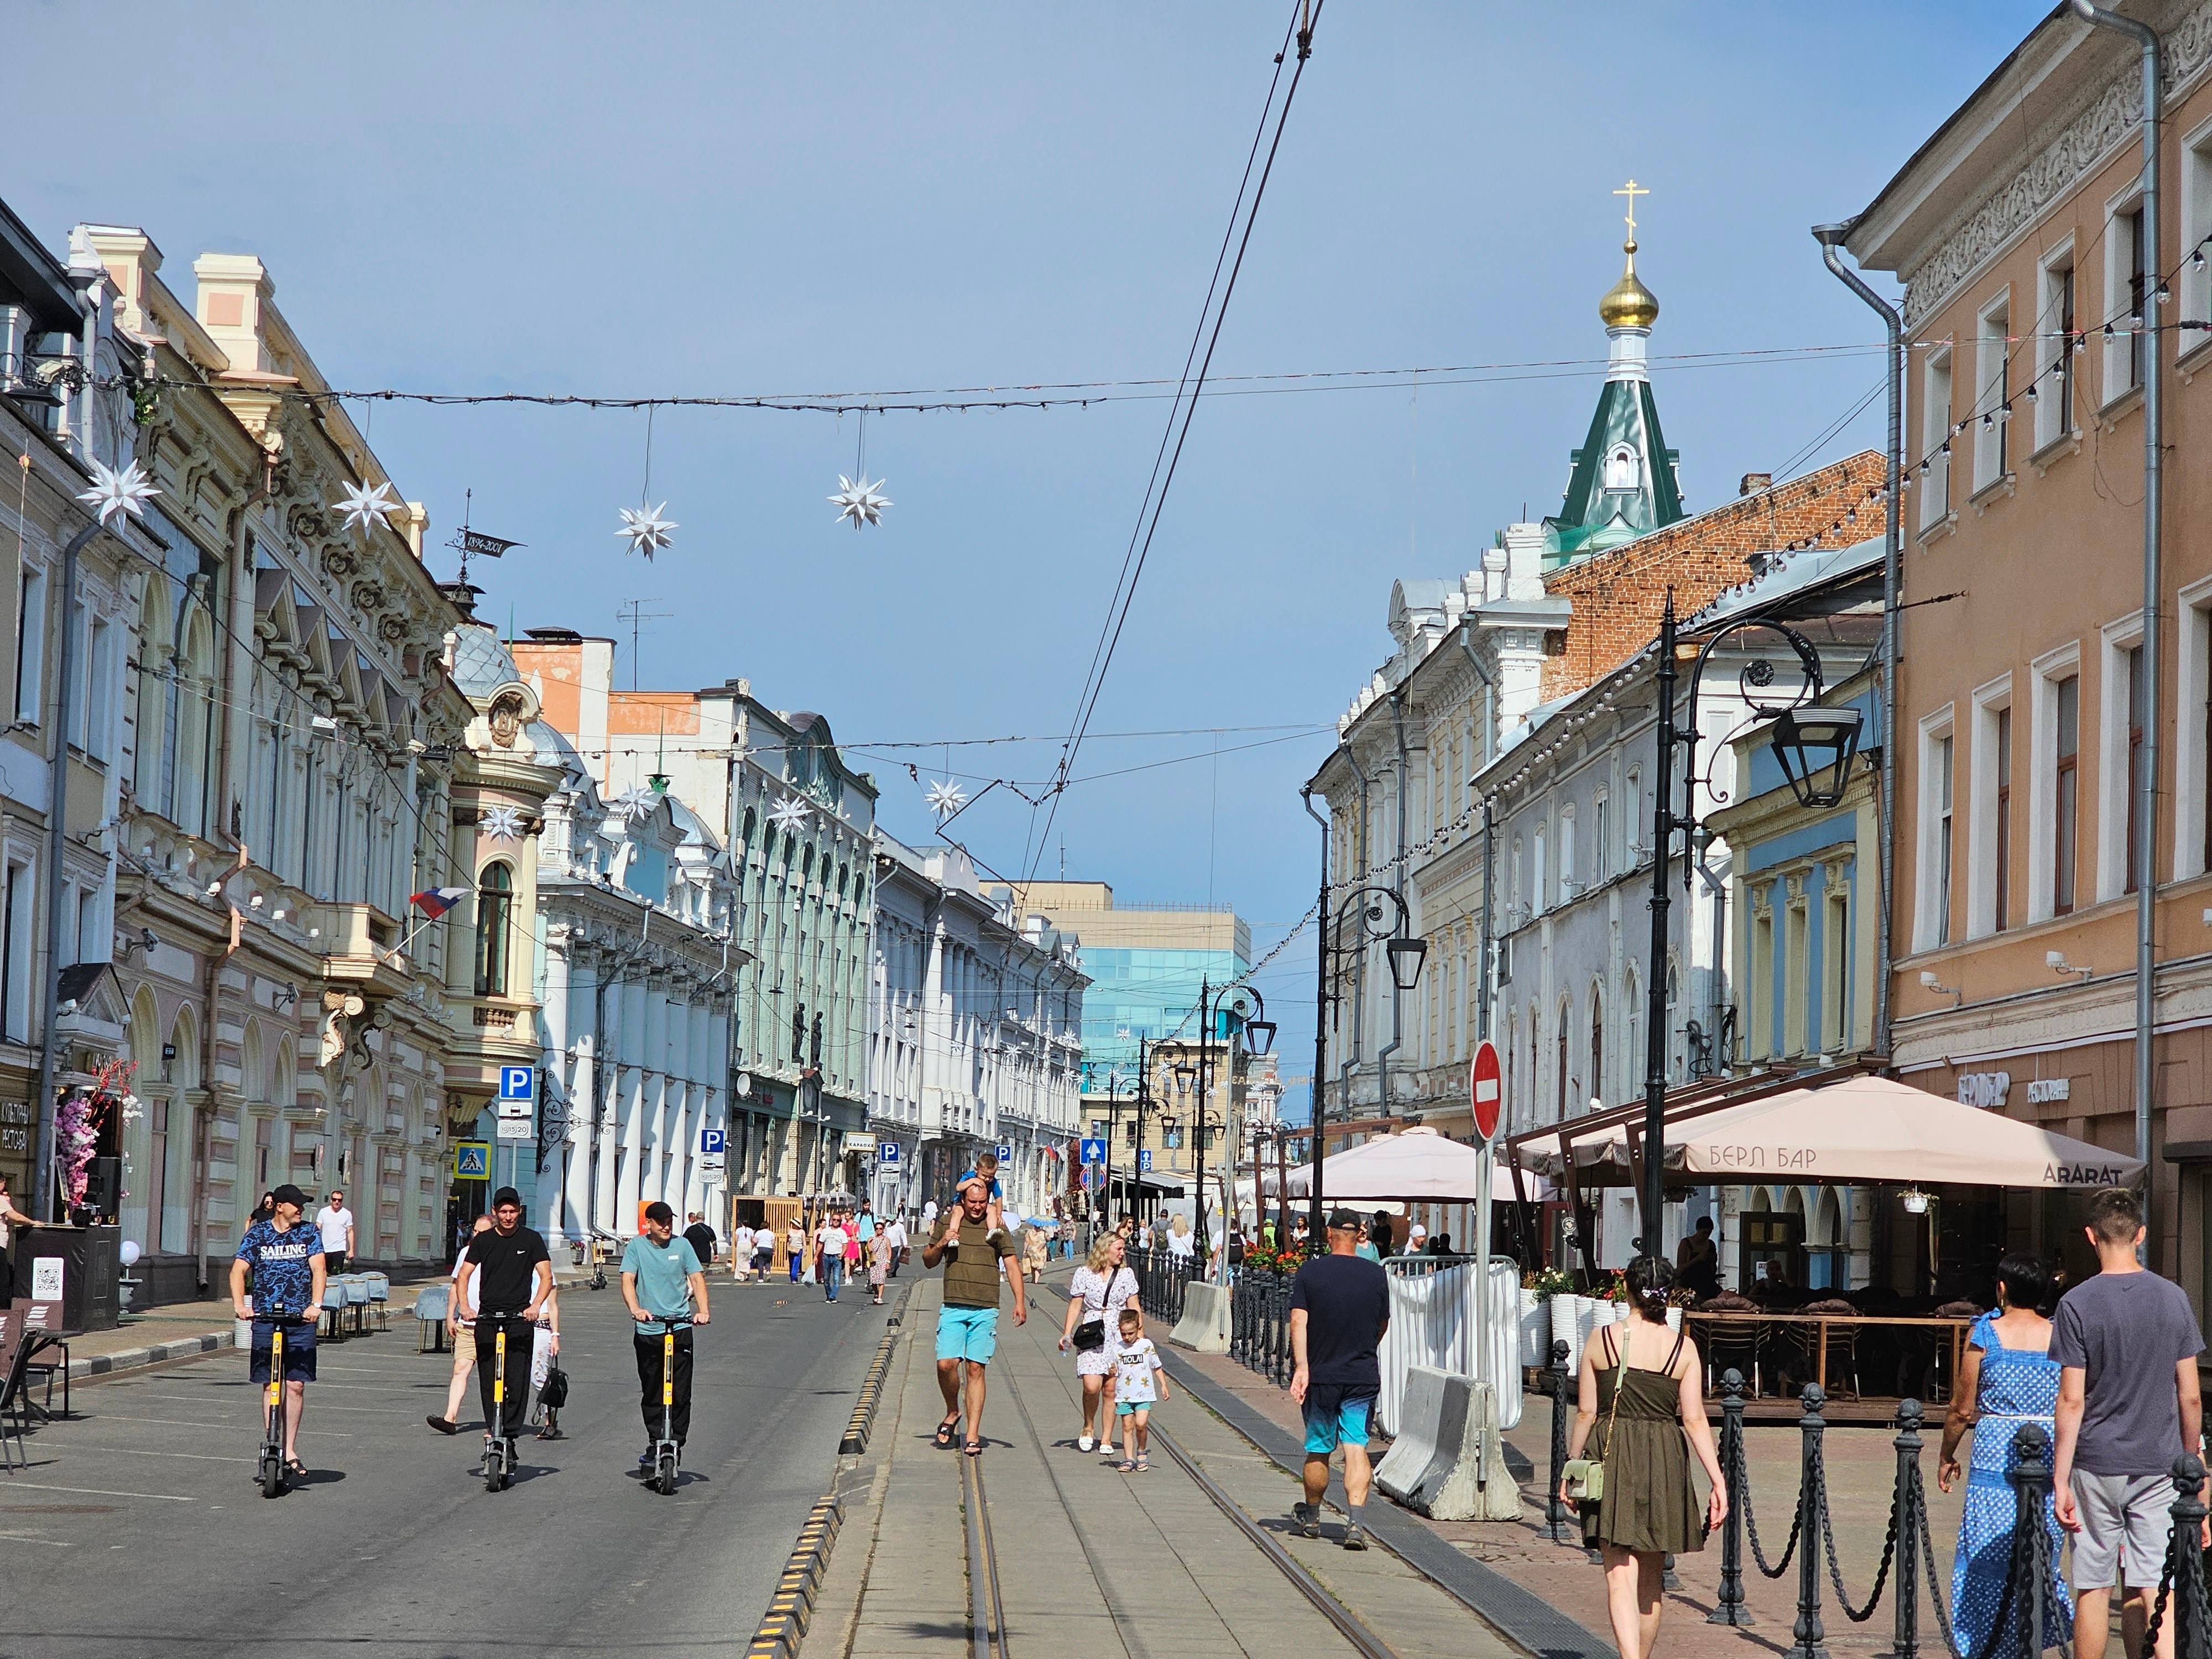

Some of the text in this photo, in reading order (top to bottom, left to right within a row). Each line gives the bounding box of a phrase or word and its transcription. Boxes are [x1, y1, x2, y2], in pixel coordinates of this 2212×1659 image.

[467, 536, 503, 553] 1894-2001
[509, 1070, 528, 1095] P
[706, 1131, 721, 1151] P
[885, 1145, 896, 1160] P
[999, 1147, 1008, 1160] P
[1778, 1147, 1817, 1168] БАР
[2043, 1162, 2123, 1186] ARARAT
[260, 1244, 307, 1256] SAILING
